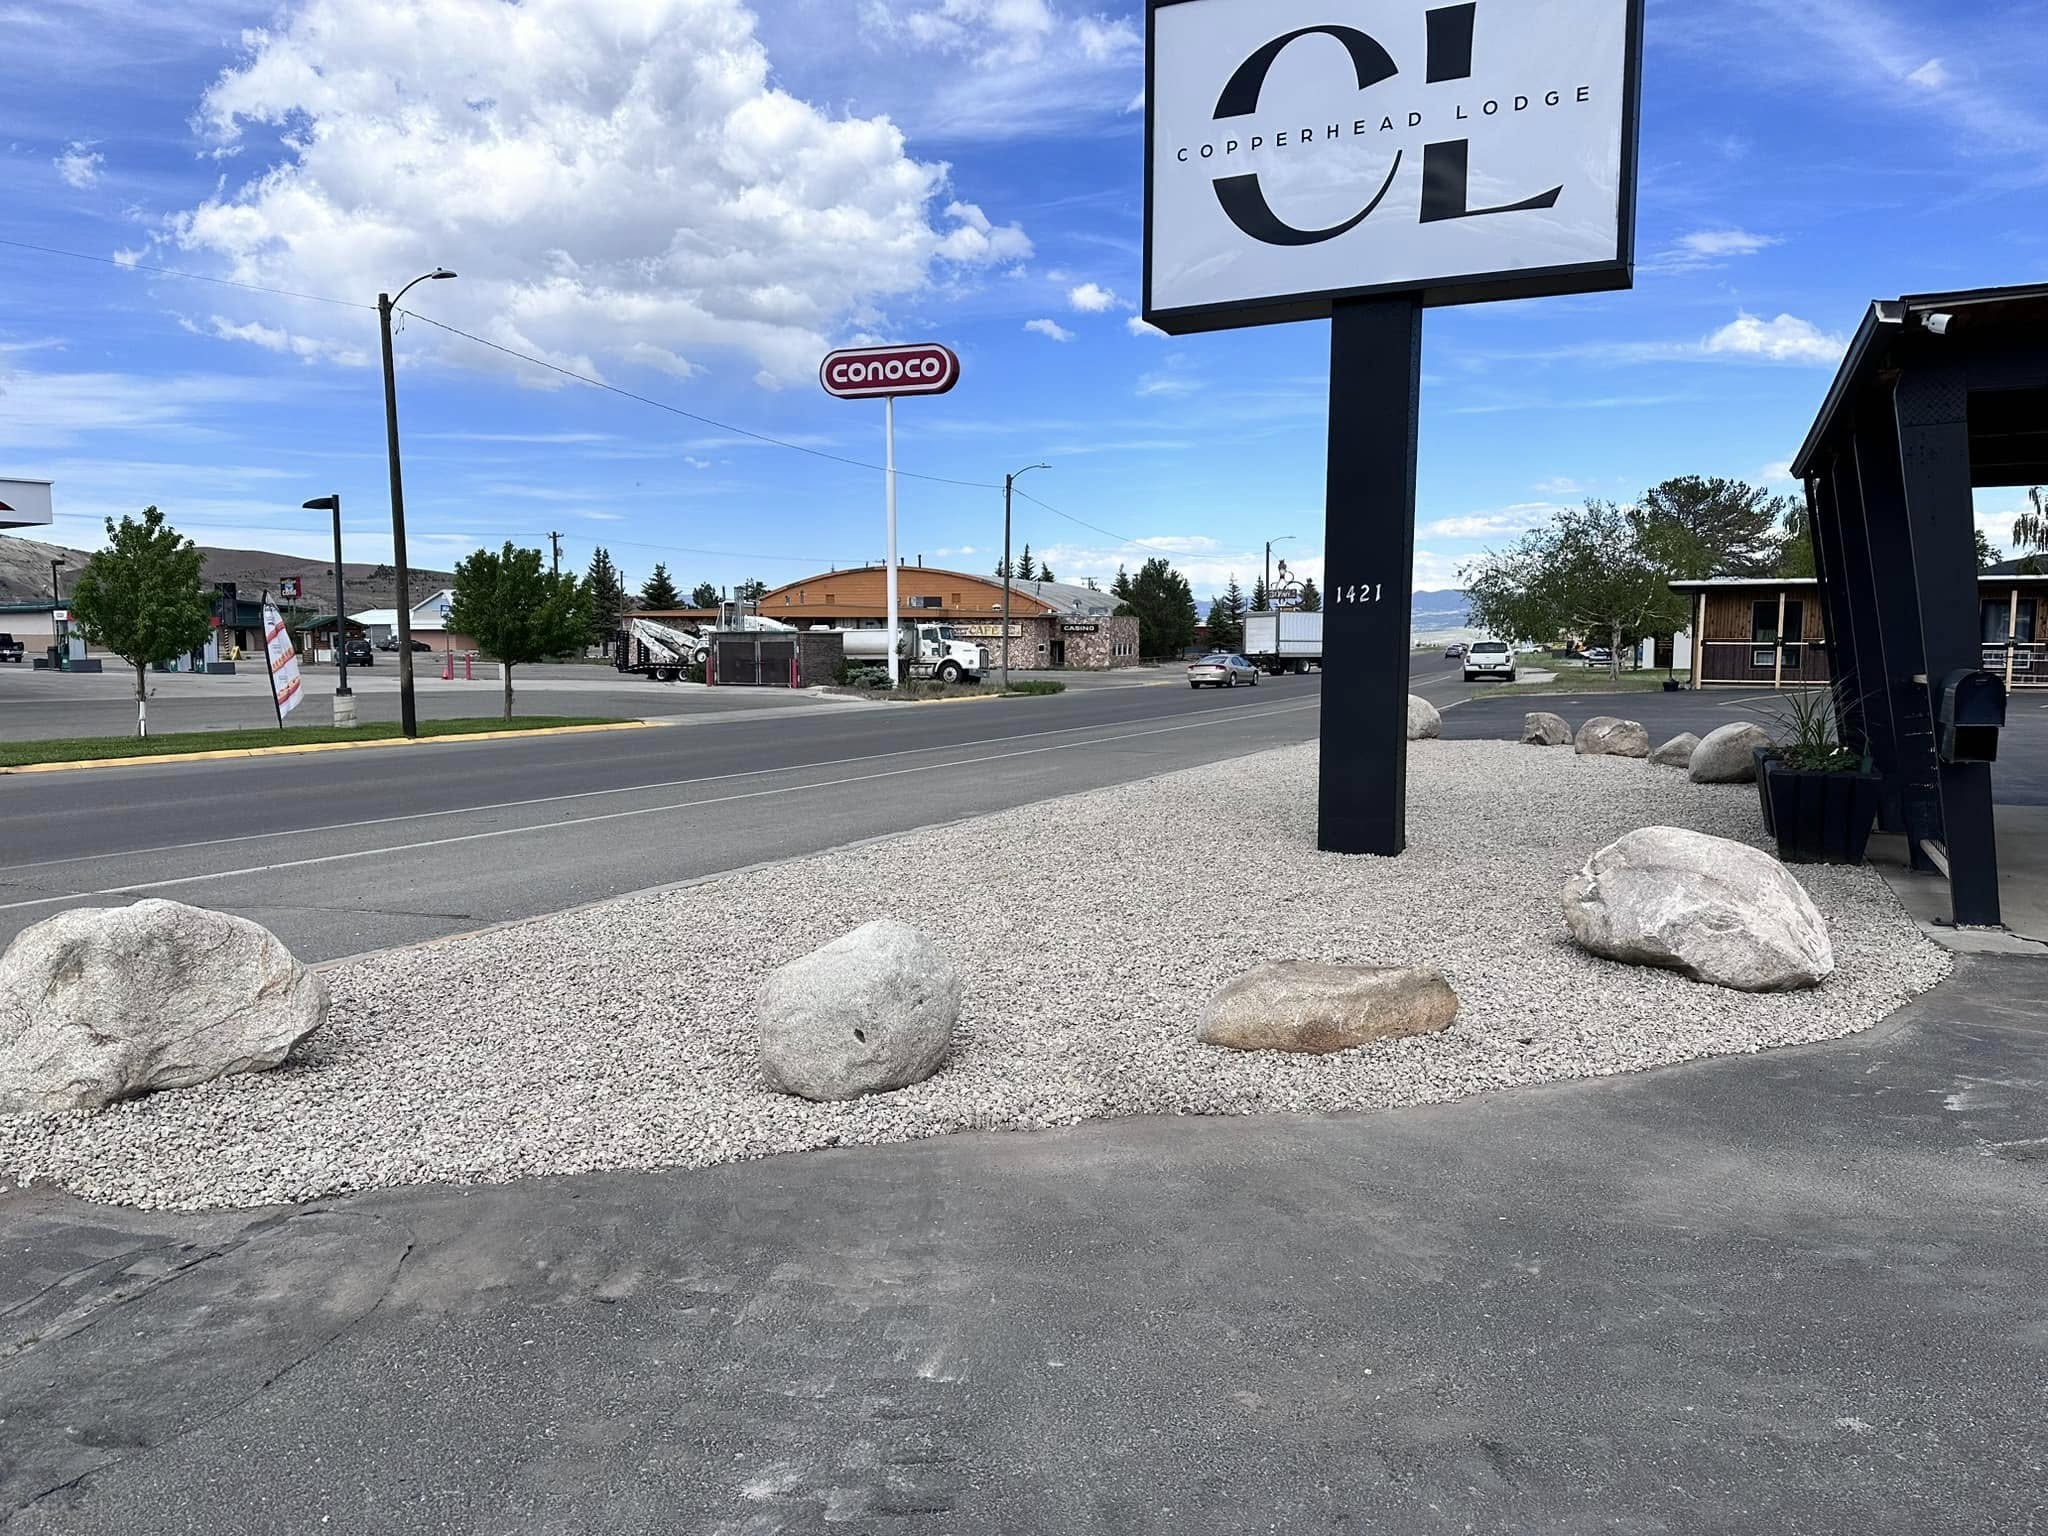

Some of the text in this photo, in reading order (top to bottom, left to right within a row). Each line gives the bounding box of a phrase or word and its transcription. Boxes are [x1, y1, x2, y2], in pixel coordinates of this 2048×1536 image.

[1177, 85, 1591, 163] COPPERHEAD LODGE
[1336, 583, 1382, 604] 1421
[969, 625, 999, 635] CAFE
